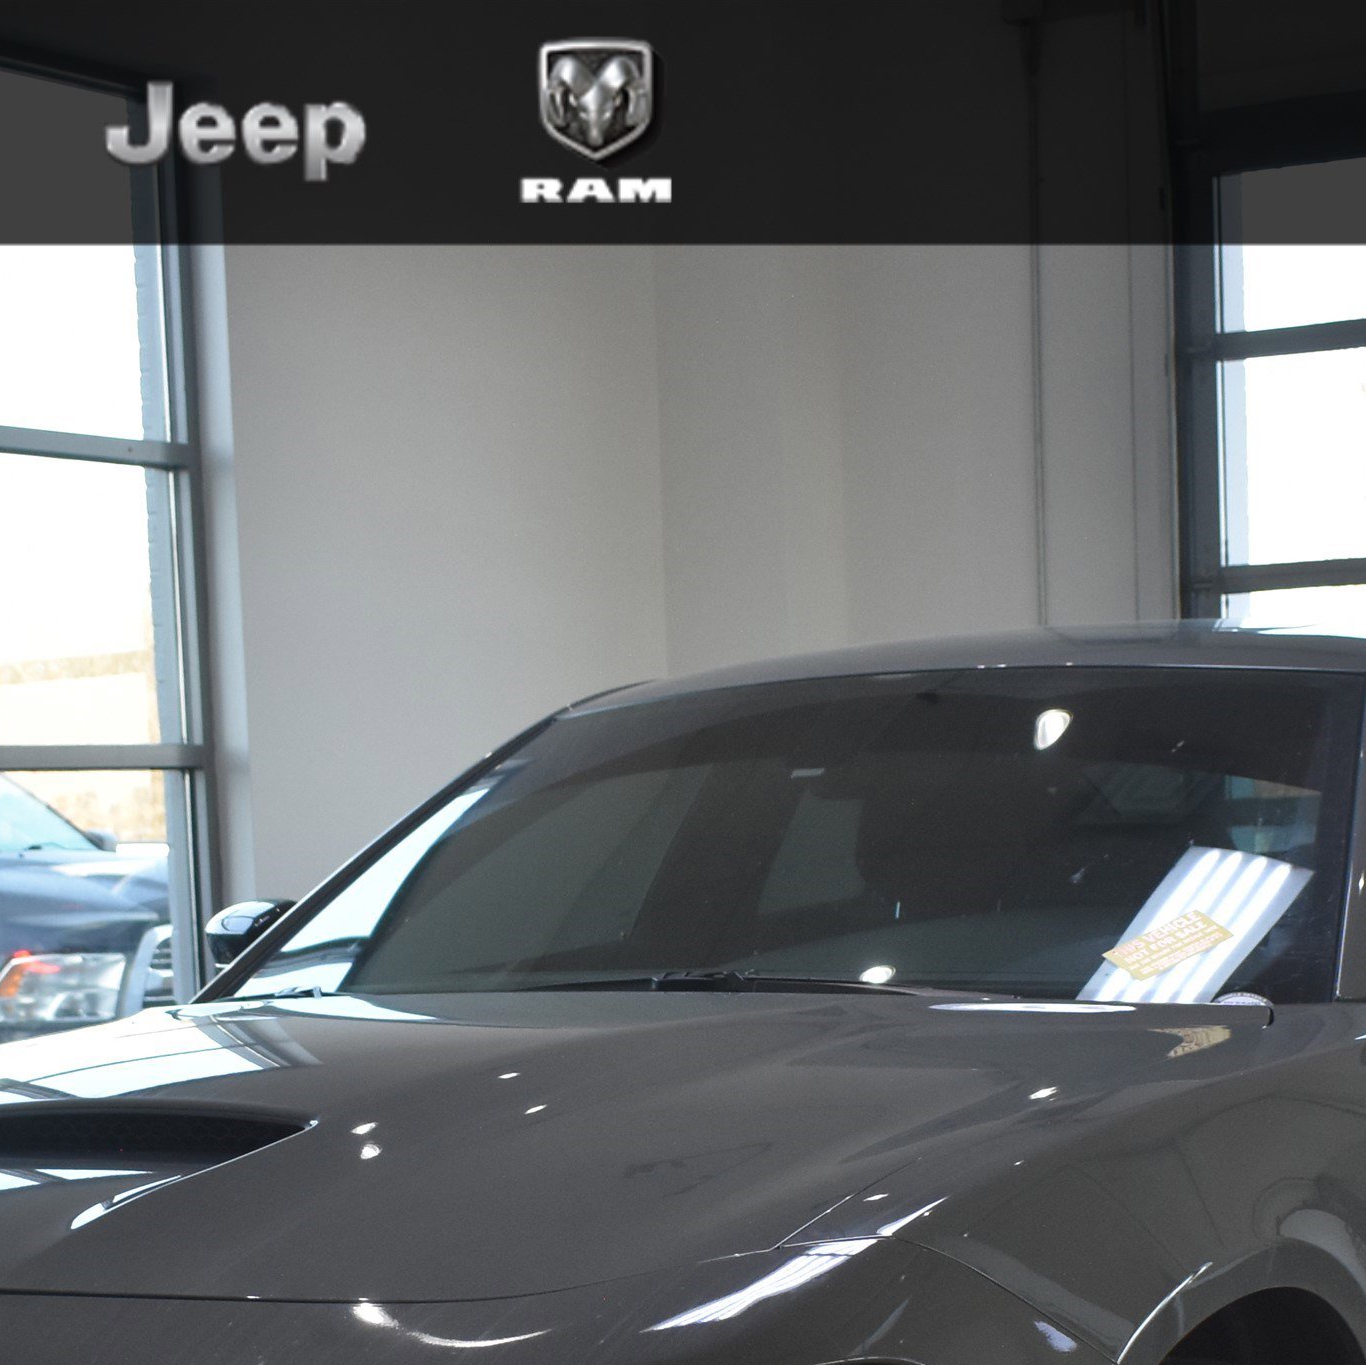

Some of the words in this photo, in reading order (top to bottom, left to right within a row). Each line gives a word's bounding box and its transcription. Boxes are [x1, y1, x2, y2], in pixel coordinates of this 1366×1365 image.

[1124, 949, 1150, 964] NOT
[1149, 935, 1176, 951] FOR
[1175, 920, 1207, 939] SALE
[1141, 911, 1202, 943] VEHICLE
